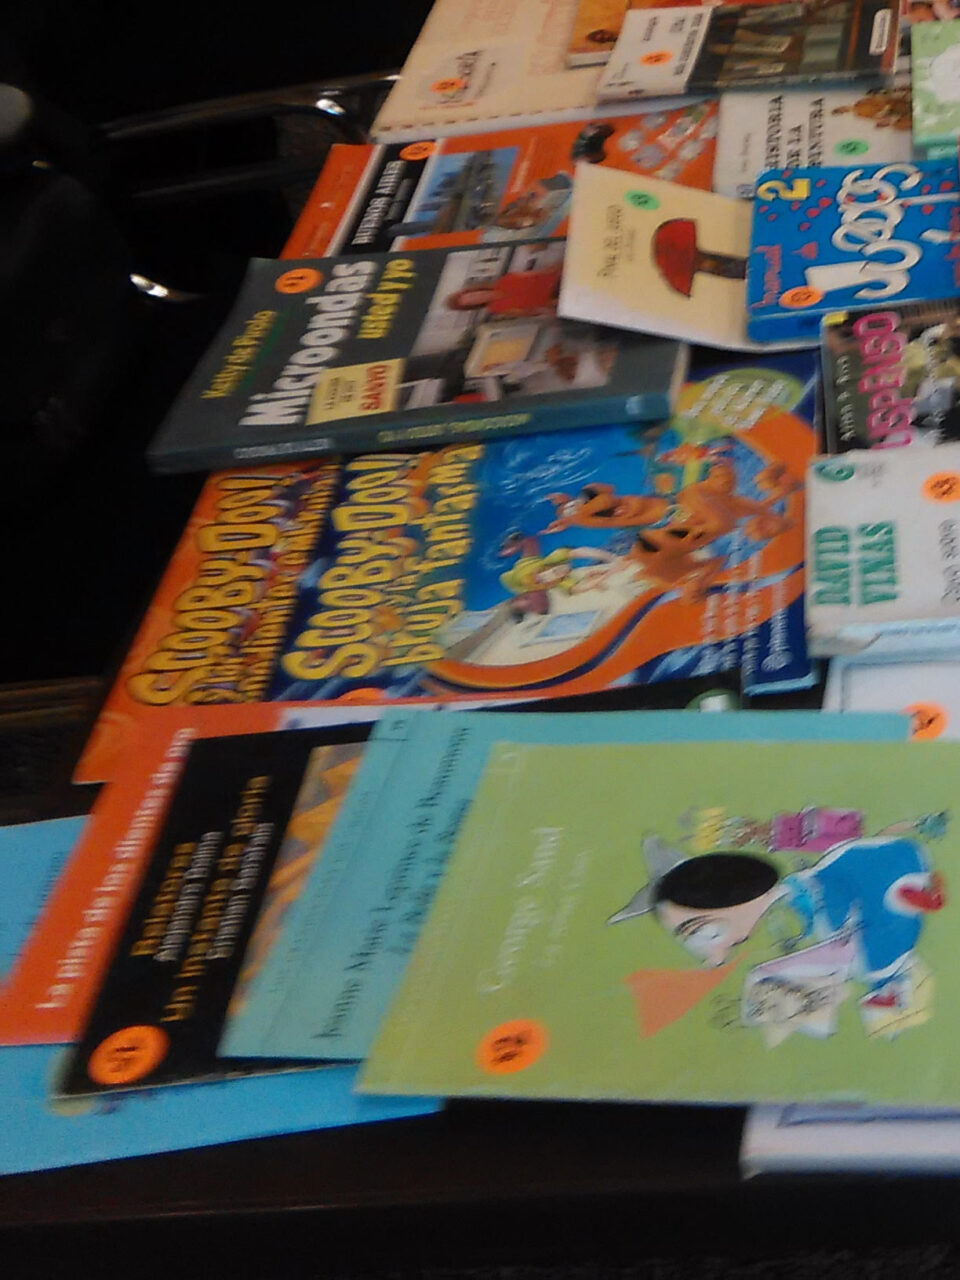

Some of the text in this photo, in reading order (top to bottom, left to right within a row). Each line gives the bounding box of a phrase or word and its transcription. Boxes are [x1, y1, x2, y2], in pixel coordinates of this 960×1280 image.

[351, 160, 407, 245] BUENOS AIRES
[756, 178, 811, 202] 2
[356, 258, 418, 340] usted y yo
[237, 261, 379, 426] Microondas
[358, 364, 392, 411] SANYO
[852, 310, 914, 451] USPENSO
[811, 526, 851, 607] DAVID
[148, 761, 188, 786] de
[112, 788, 170, 860] dientes
[92, 863, 130, 893] los
[81, 896, 121, 923] de
[54, 927, 104, 979] pista
[34, 983, 74, 1009] La
